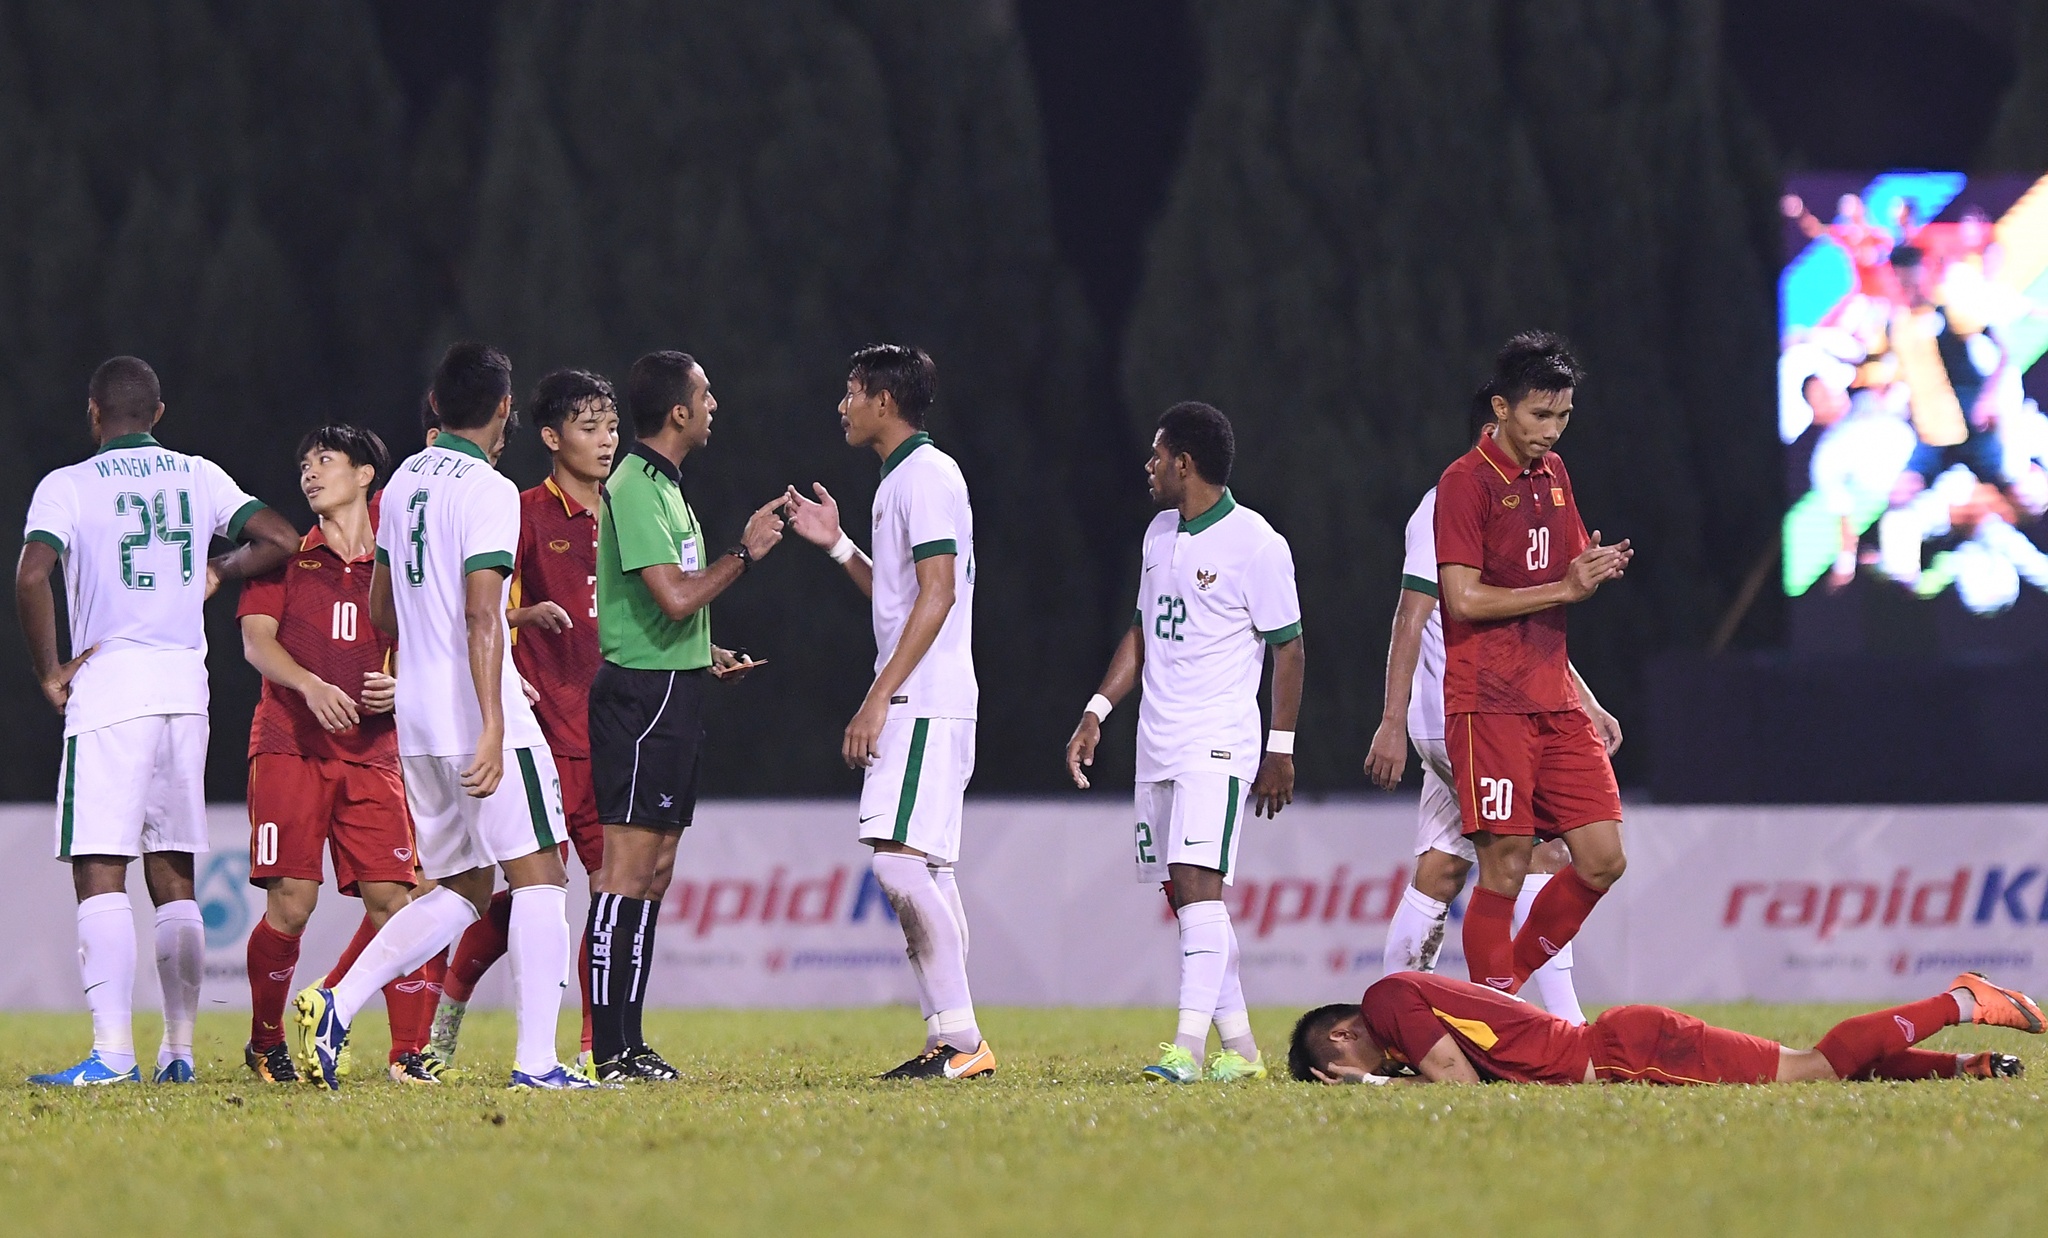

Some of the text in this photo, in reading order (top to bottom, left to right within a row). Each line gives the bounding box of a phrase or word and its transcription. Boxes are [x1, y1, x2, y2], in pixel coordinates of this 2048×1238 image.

[114, 488, 195, 590] 24
[405, 487, 430, 588] 3
[1526, 526, 1550, 571] 20
[332, 601, 358, 641] 10
[1155, 594, 1187, 643] 22
[1480, 776, 1514, 820] 20
[257, 821, 279, 866] 10
[1135, 821, 1157, 864] 2
[592, 931, 613, 971] FBT
